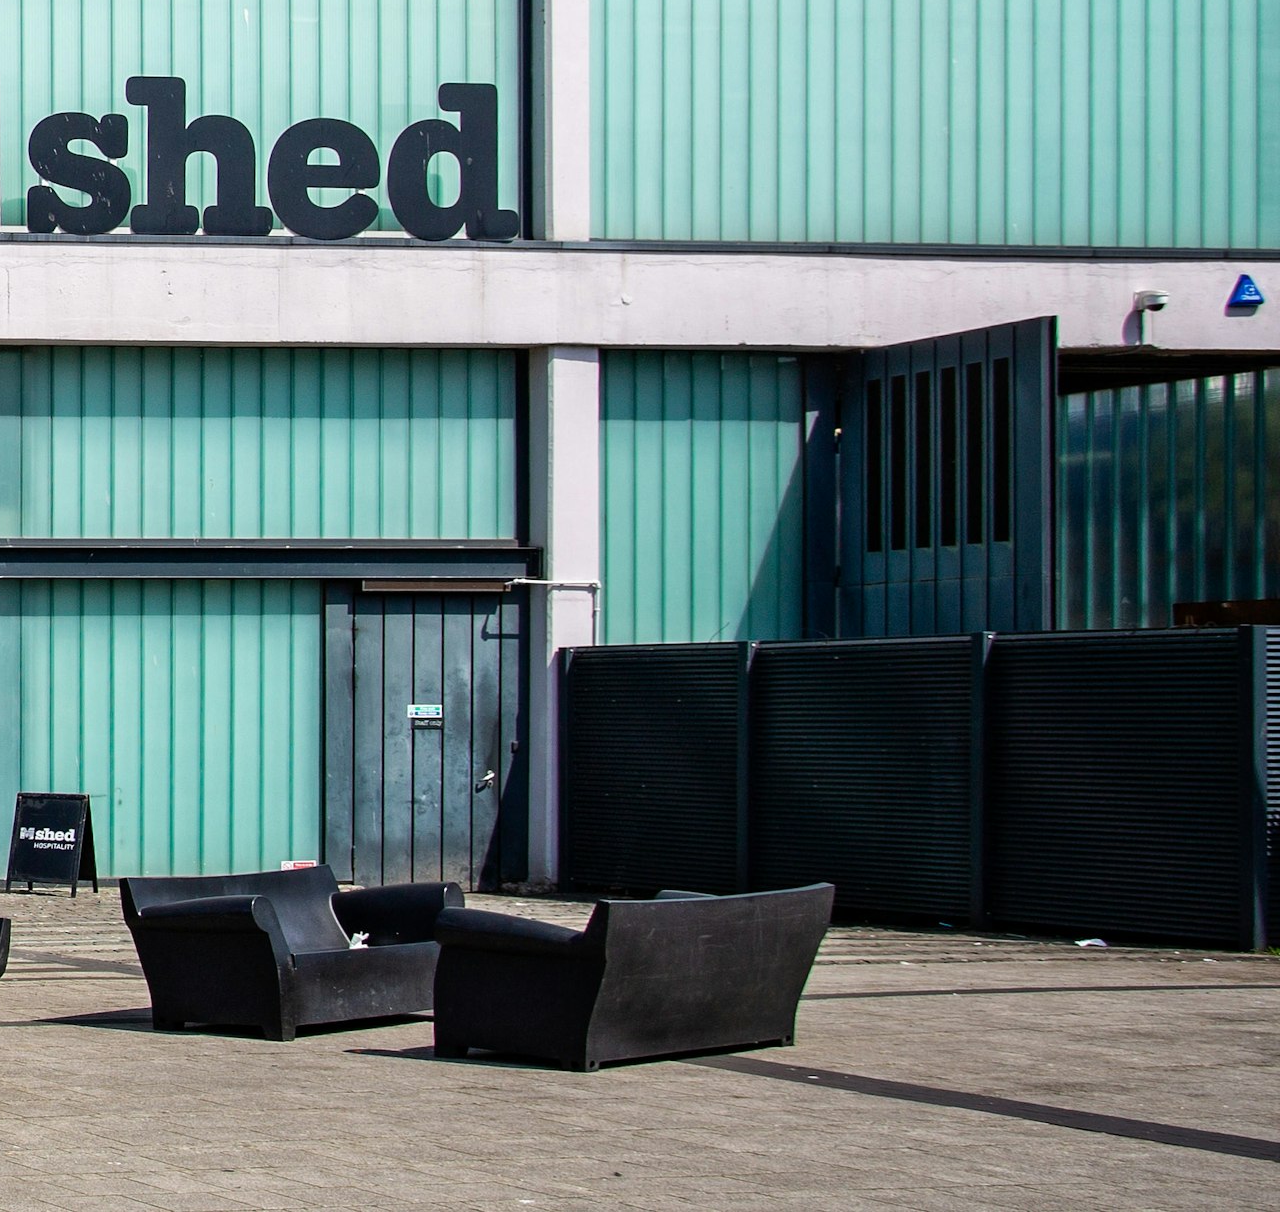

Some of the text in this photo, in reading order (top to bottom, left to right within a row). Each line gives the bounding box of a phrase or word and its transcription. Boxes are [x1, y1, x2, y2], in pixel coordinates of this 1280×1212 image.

[27, 76, 519, 241] shed
[35, 828, 75, 842] shed
[34, 842, 75, 850] HOSPITALITY
